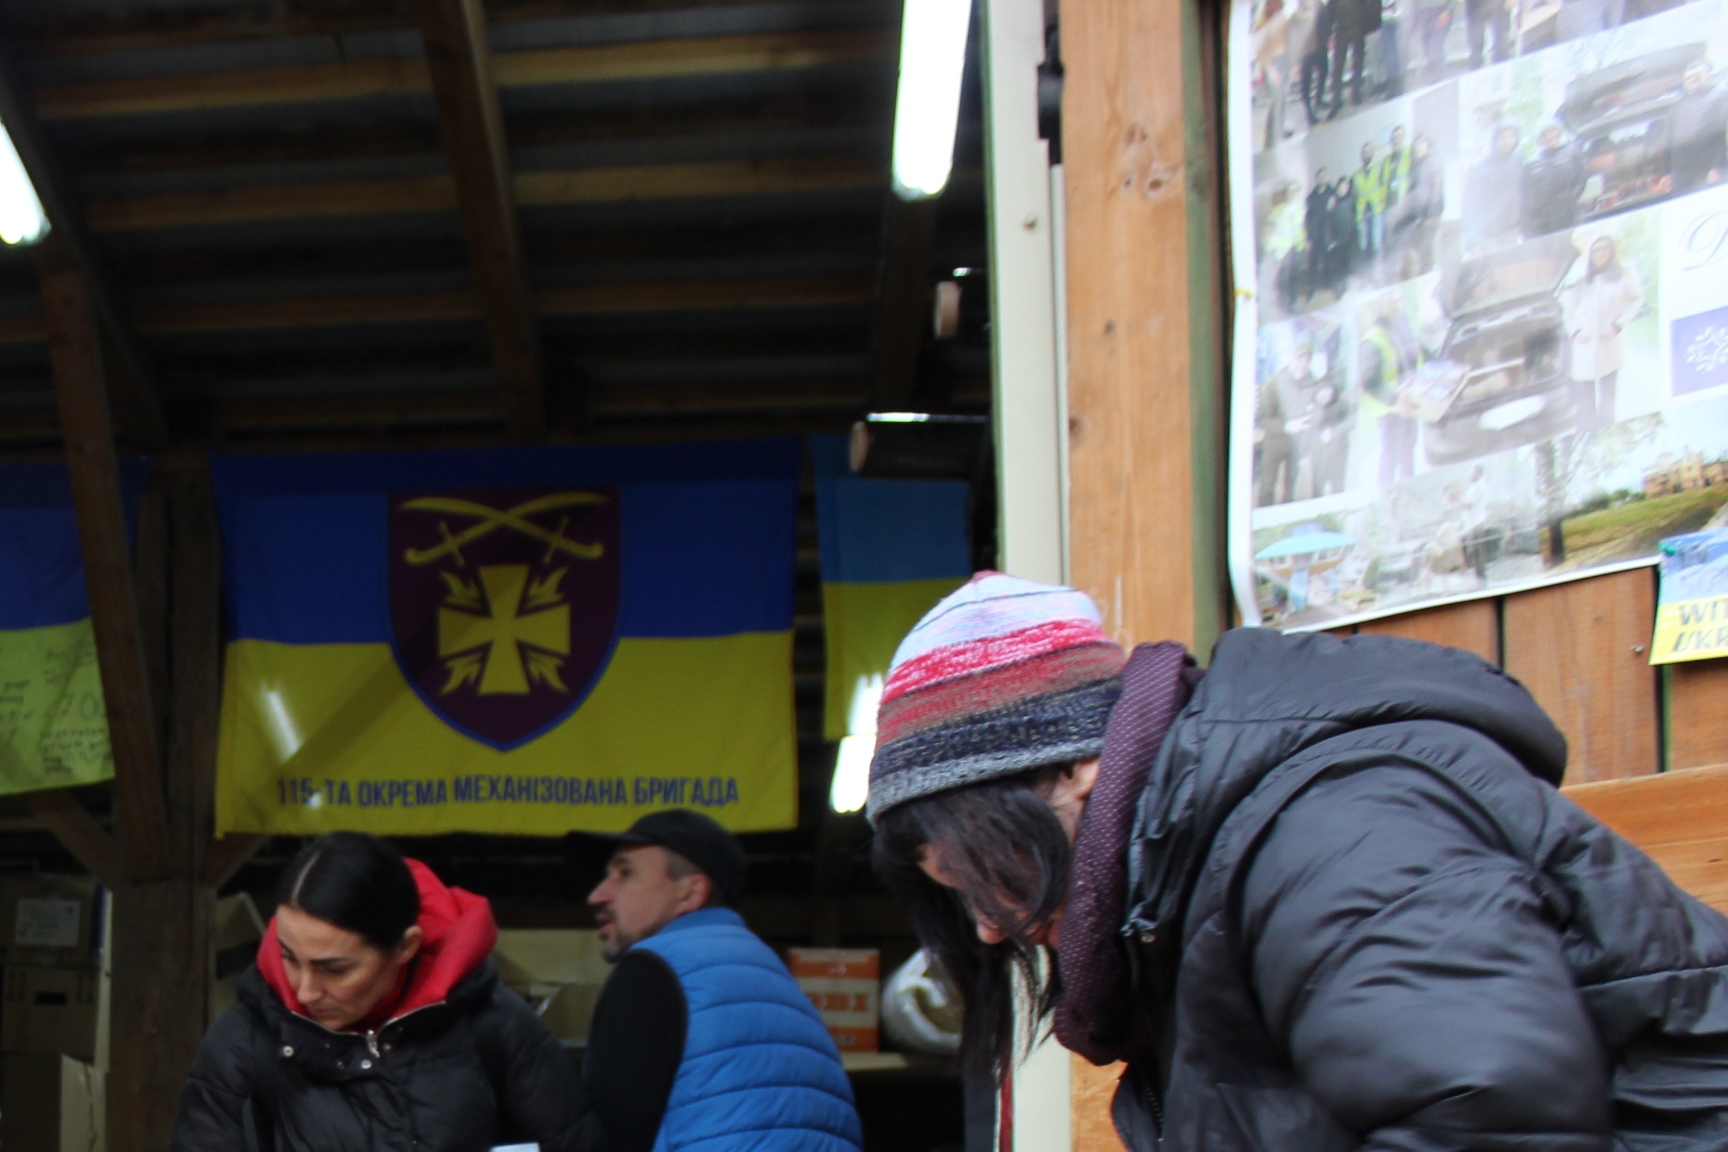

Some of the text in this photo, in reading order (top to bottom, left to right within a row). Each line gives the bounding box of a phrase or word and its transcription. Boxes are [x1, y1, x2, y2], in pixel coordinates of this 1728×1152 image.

[358, 780, 448, 808] ОКРЕМА
[453, 775, 627, 806] МЕХАНІЗОВАНА
[634, 777, 739, 808] БРИГАДА
